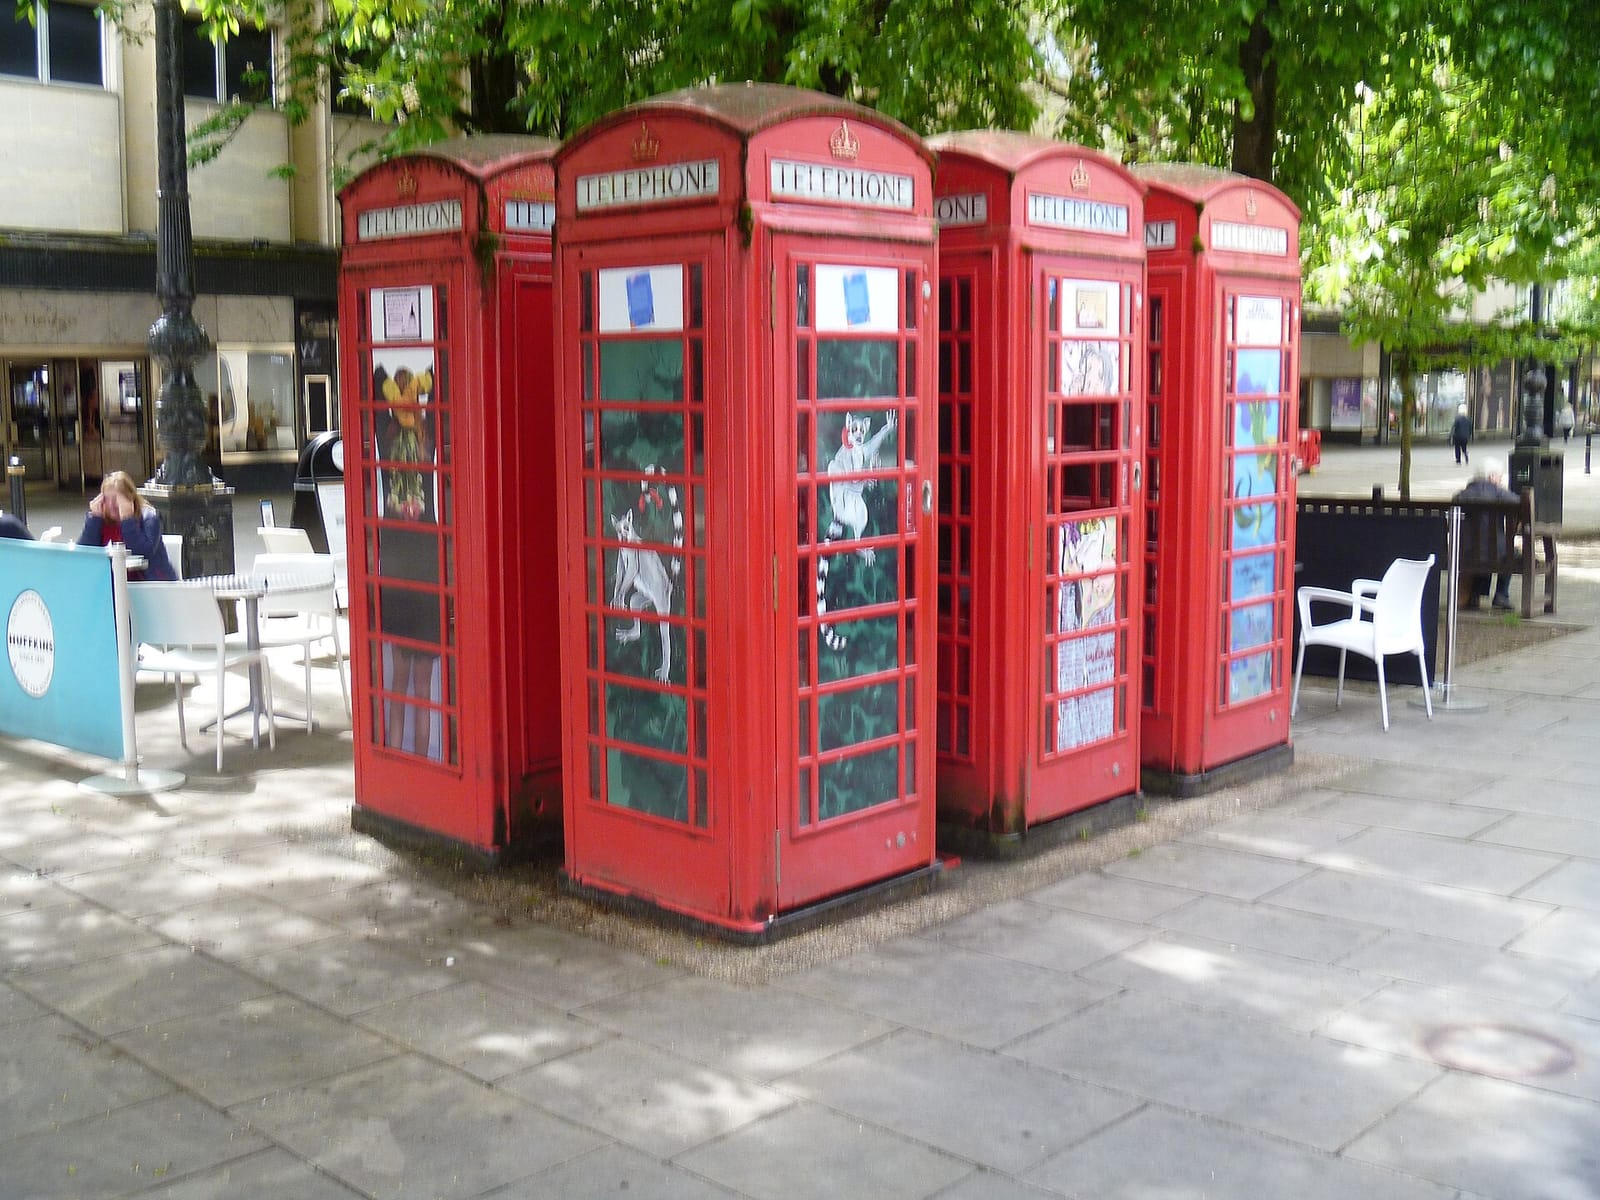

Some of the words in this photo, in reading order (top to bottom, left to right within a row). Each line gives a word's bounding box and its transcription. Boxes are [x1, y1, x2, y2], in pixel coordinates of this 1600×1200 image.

[581, 161, 716, 205] TELEPHONE
[775, 161, 908, 207] TELEPHONE
[361, 200, 461, 237] TELEPHONE
[1030, 194, 1126, 232] TELEPHONE
[1211, 222, 1285, 253] TELEPHONE
